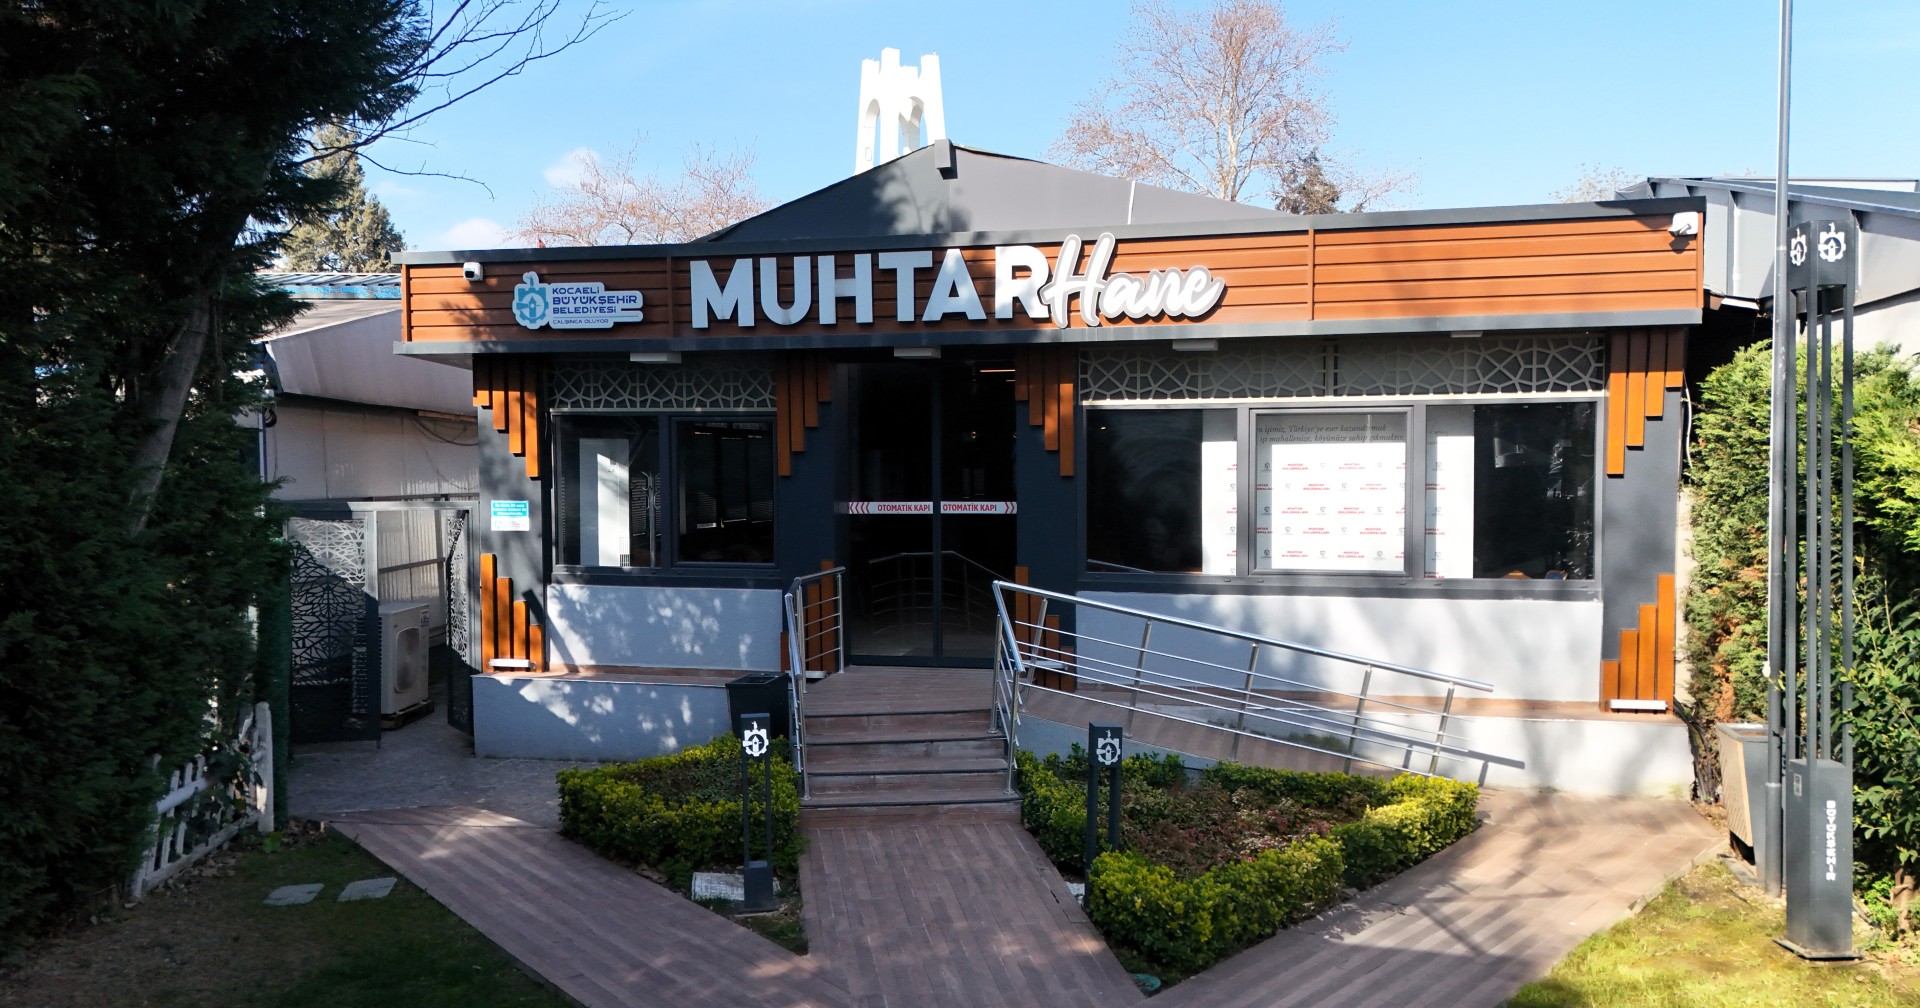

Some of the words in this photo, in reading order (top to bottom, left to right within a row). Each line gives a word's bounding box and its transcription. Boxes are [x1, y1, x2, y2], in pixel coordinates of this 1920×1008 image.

[690, 245, 1050, 328] MUHTAR
[1040, 233, 1225, 329] Hane
[552, 287, 600, 295] KOCAELİ
[552, 295, 638, 305] BÜYÜKŞEHİR
[552, 306, 617, 314] BELEDİYESİ
[877, 502, 913, 512] OTOMATİK
[913, 504, 931, 512] KAPI
[942, 502, 978, 512] OTOMATİK
[980, 504, 997, 512] KAPI
